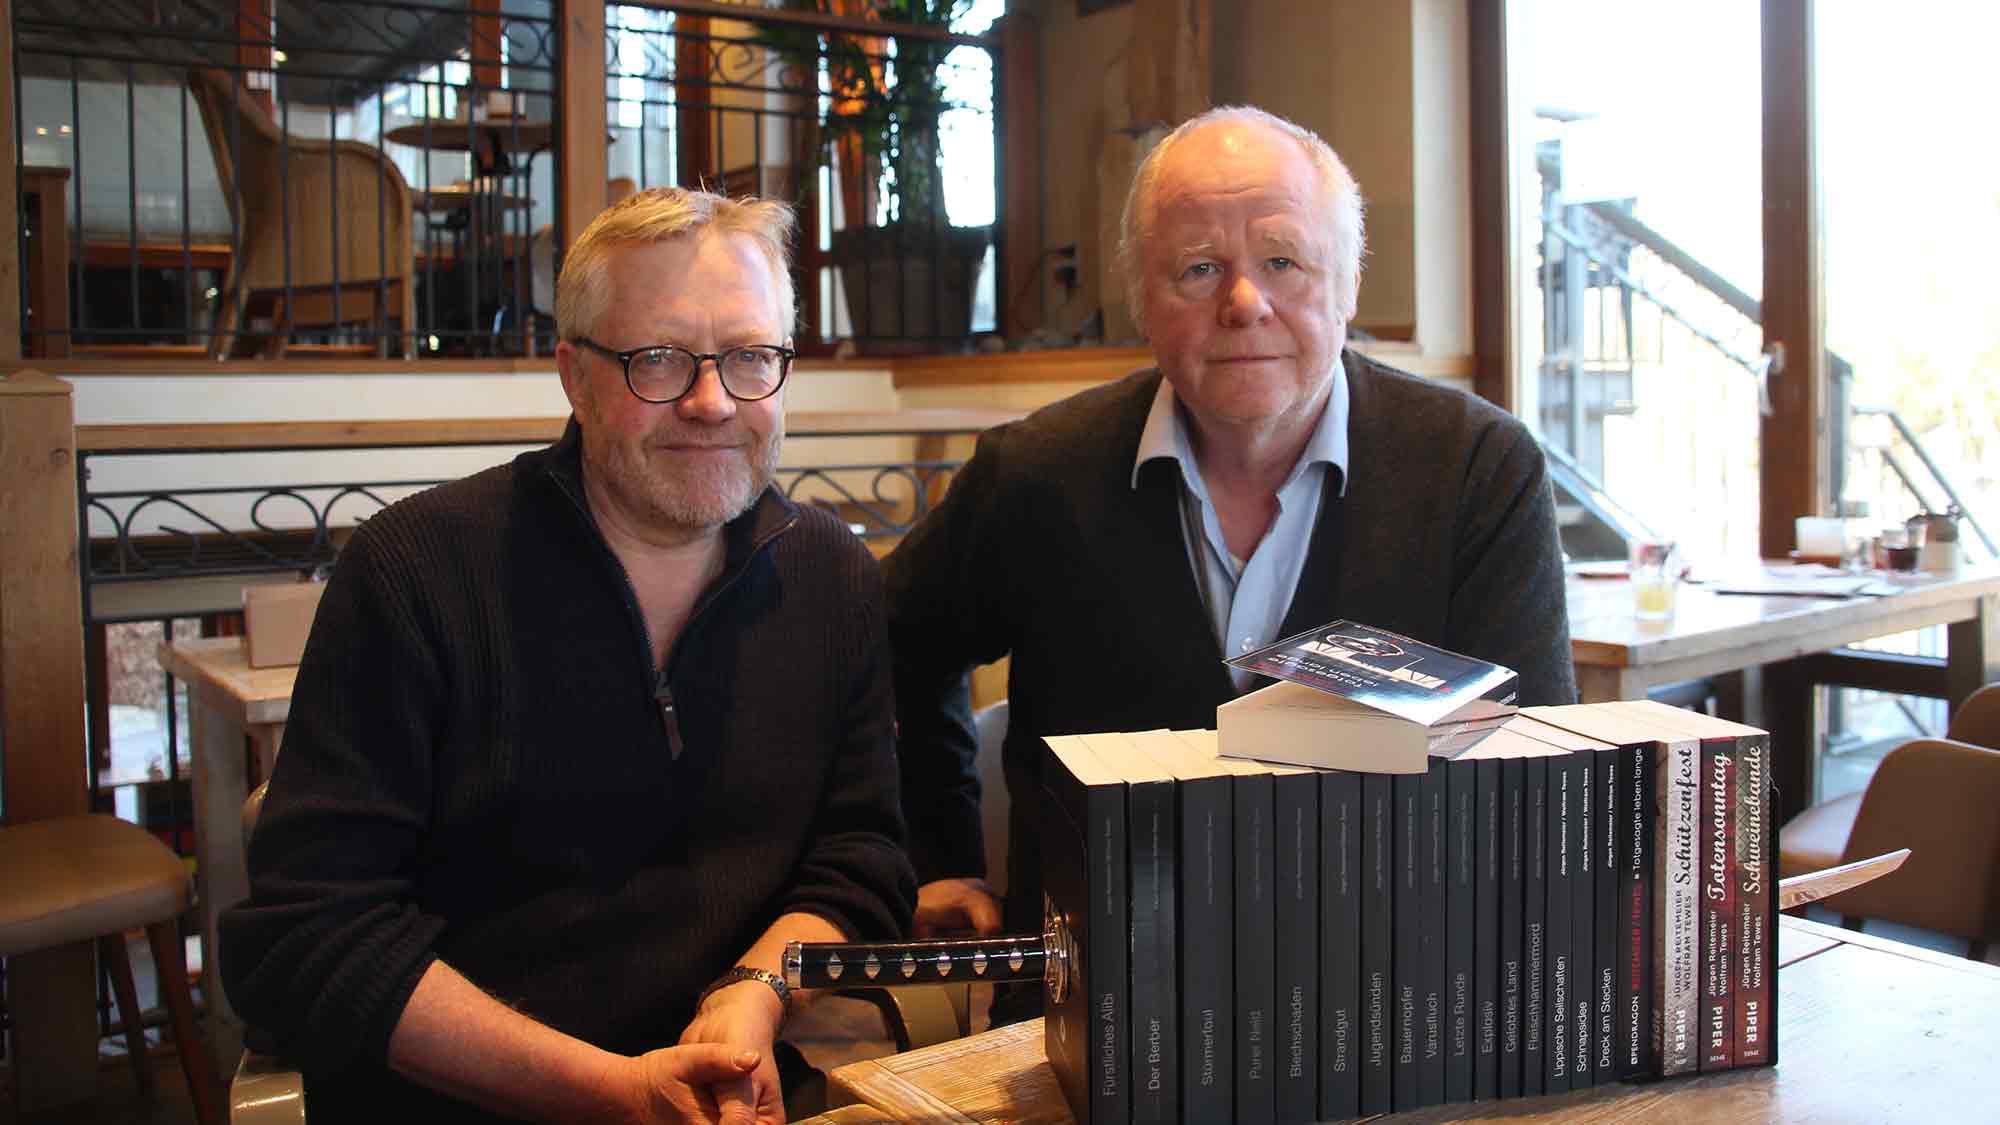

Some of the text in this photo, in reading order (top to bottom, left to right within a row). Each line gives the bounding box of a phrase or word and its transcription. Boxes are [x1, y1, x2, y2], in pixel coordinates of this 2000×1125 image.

[1634, 748, 1642, 778] lange
[1633, 813, 1642, 869] Totgesagte
[1674, 748, 1697, 885] Schützenfest
[1708, 753, 1732, 901] Totensonntag
[1743, 746, 1761, 894] Schweinebande
[1528, 923, 1540, 1050] Fleischhammermord
[1708, 965, 1716, 996] Jürgen
[1719, 955, 1727, 995] Wolfram
[1743, 957, 1751, 989] Jürgen
[1753, 948, 1761, 987] Wolfram
[1289, 986, 1302, 1078] Blechschaden
[1334, 1009, 1348, 1072] Strandgut
[1369, 972, 1383, 1066] Jugendsünden
[1400, 985, 1414, 1064] Bauernopfer
[1425, 992, 1438, 1058] Varusfluch
[1454, 974, 1465, 1056] Letzte Runde
[1482, 1000, 1494, 1053] Explosiv
[1505, 961, 1517, 1052] Gelobtes Land
[1555, 957, 1566, 1077] Lippische Seilschaften
[1577, 1001, 1588, 1072] Schnapsidee
[1600, 968, 1611, 1068] Dreck am Stecken
[1631, 996, 1639, 1057] PENDRAGON
[1675, 1010, 1685, 1052] PIPER
[1712, 1006, 1723, 1048] PIPER
[1746, 1001, 1757, 1043] PIPER
[1101, 993, 1116, 1096] Fürstliches Alibi
[1148, 1019, 1160, 1090] Der Berber
